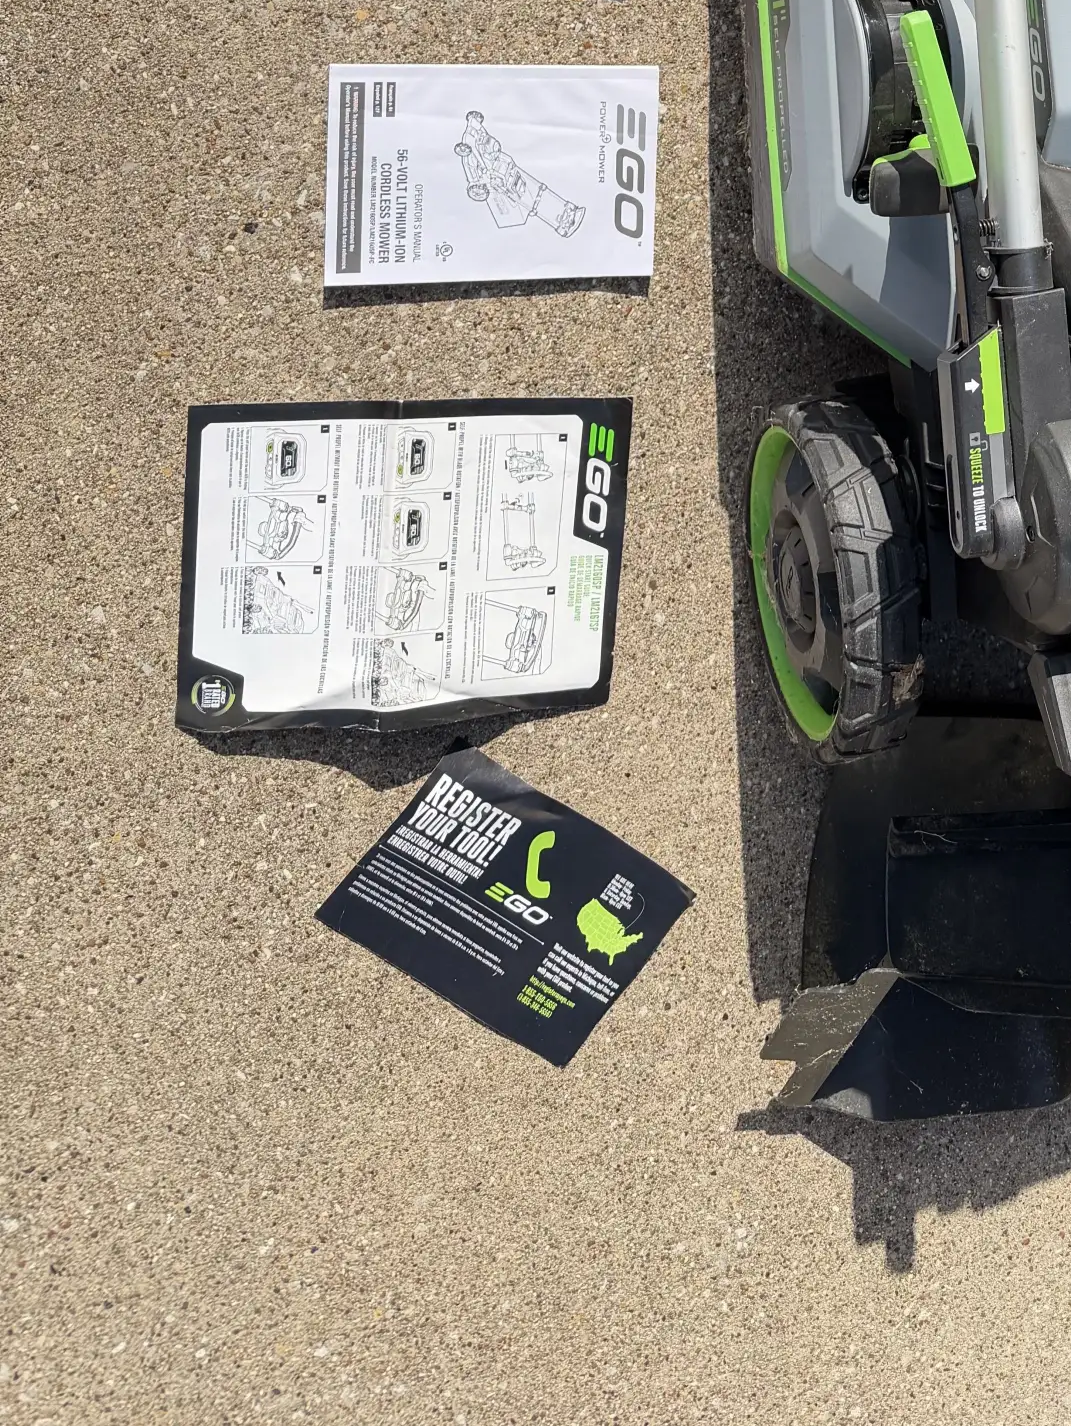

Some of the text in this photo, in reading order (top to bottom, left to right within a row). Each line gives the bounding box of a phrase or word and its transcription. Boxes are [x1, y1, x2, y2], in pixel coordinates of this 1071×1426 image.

[772, 15, 789, 174] SELF PROPELLED
[394, 149, 408, 262] 56-VOLT LITHIUM-ION
[612, 104, 647, 238] EGO
[378, 163, 391, 263] CORDLESS MOWER
[412, 183, 423, 262] OPERATOR'S MANUAL
[582, 423, 614, 531] EGO
[968, 447, 987, 533] SQUEEZE TO UNLOCK
[407, 801, 502, 866] YOUR TOOL!
[424, 773, 521, 845] REGISTER
[430, 844, 440, 854] LA
[427, 856, 448, 873] VOTRE
[484, 882, 548, 924] EGO
